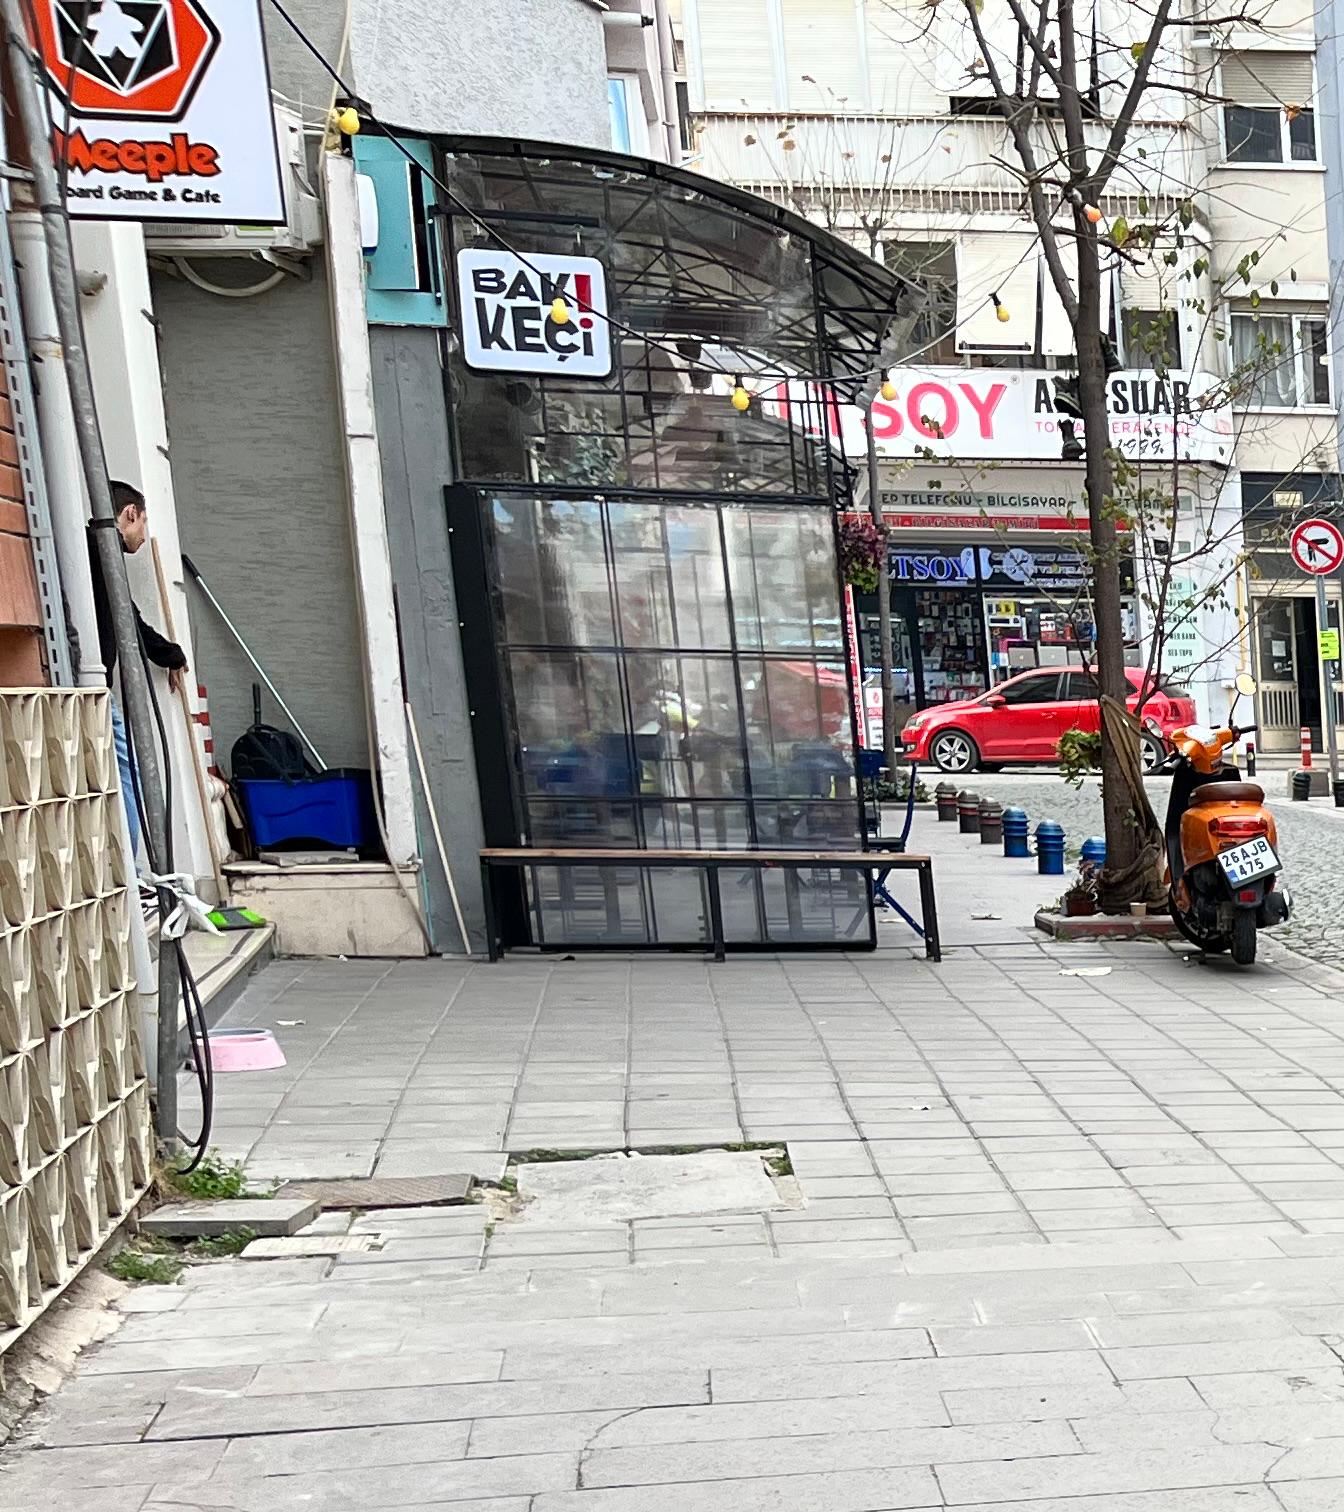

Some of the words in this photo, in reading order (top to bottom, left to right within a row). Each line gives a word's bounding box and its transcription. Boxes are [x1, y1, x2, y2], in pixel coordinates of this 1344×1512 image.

[52, 126, 222, 182] Meeple
[66, 185, 104, 200] oard
[109, 186, 158, 201] Game
[162, 188, 176, 202] &
[182, 188, 222, 204] Cafe
[1239, 858, 1264, 876] 475
